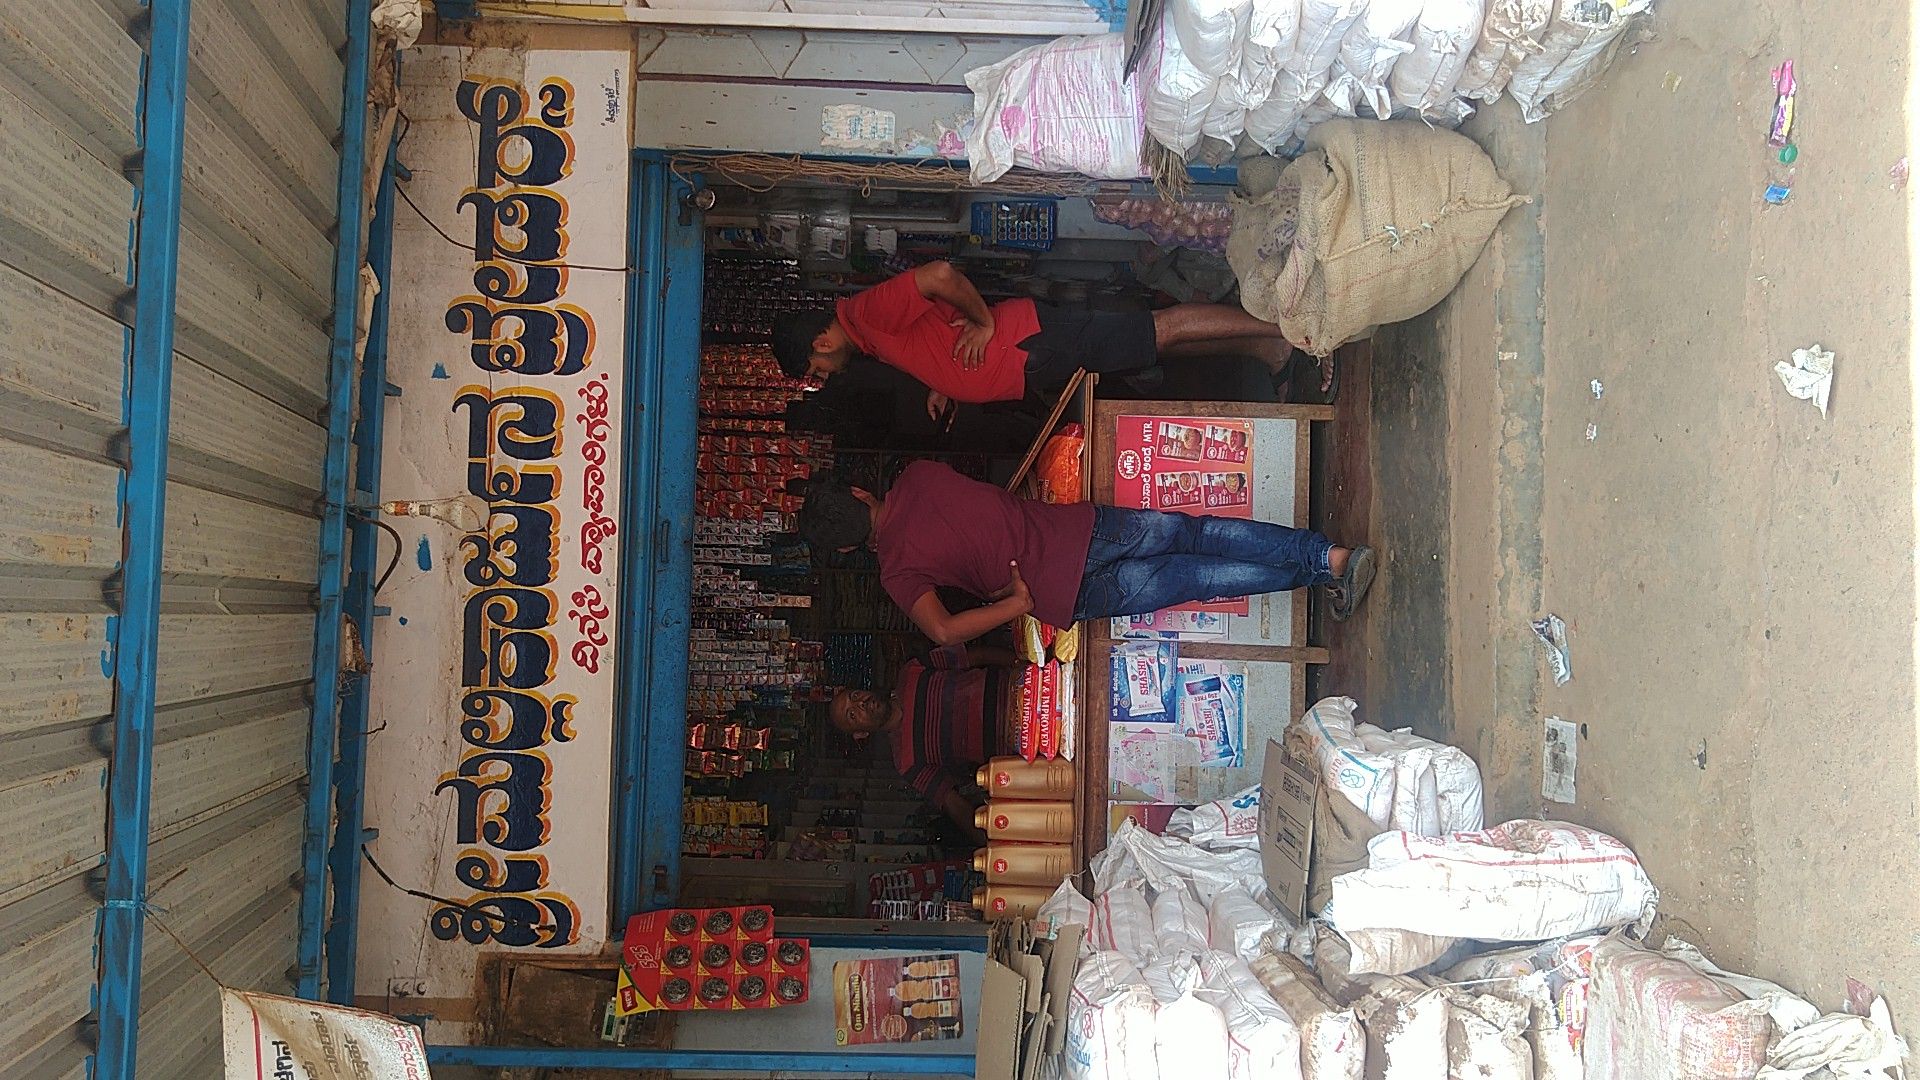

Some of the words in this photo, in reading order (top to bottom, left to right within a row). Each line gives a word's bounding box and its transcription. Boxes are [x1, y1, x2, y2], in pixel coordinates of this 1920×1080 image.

[1124, 455, 1134, 474] MTR
[569, 584, 610, 674] ದಿನಸಿ
[1042, 686, 1050, 694] &
[1137, 660, 1149, 696] SHASHI
[1020, 698, 1031, 748] IMPROVED
[1040, 696, 1050, 746] IMPROVED
[1202, 710, 1217, 740] SHASHI
[630, 944, 658, 968] 555
[624, 990, 633, 1008] NEW
